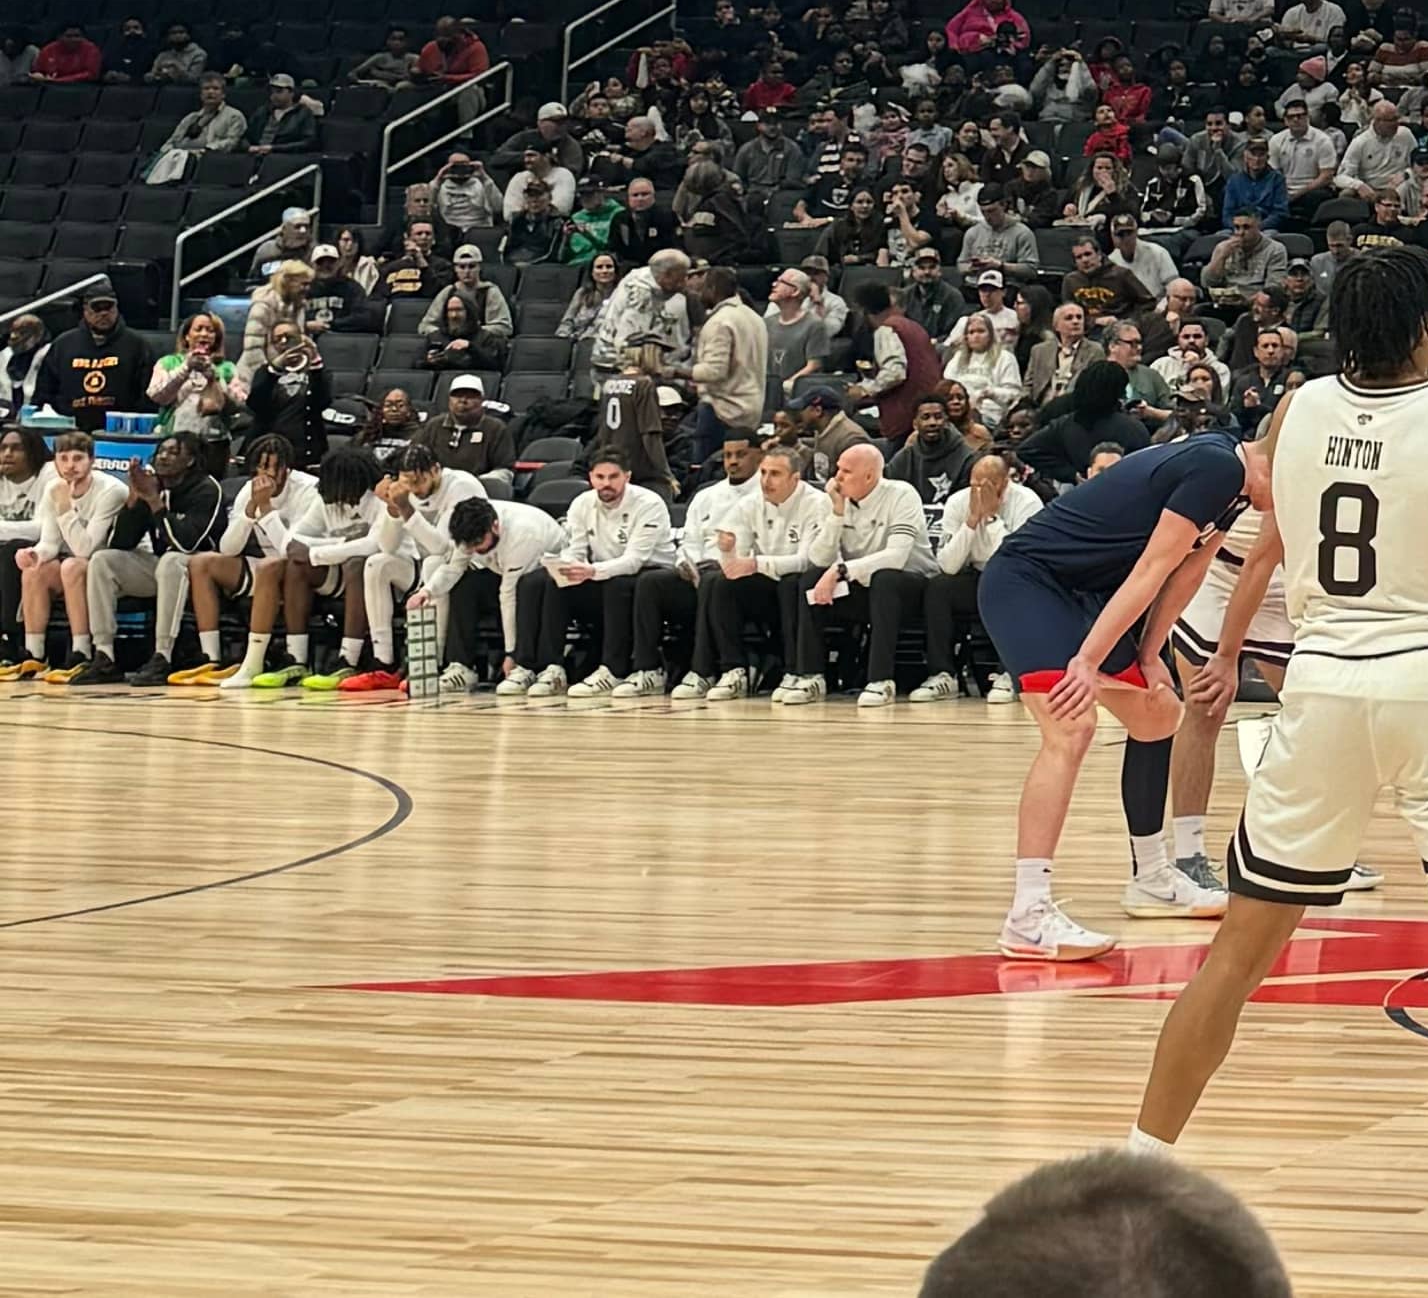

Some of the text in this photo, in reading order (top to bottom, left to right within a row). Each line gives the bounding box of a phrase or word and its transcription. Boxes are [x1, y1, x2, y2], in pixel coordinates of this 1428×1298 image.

[606, 397, 621, 430] 0
[1325, 436, 1383, 470] HINTON
[1317, 481, 1380, 597] 8
